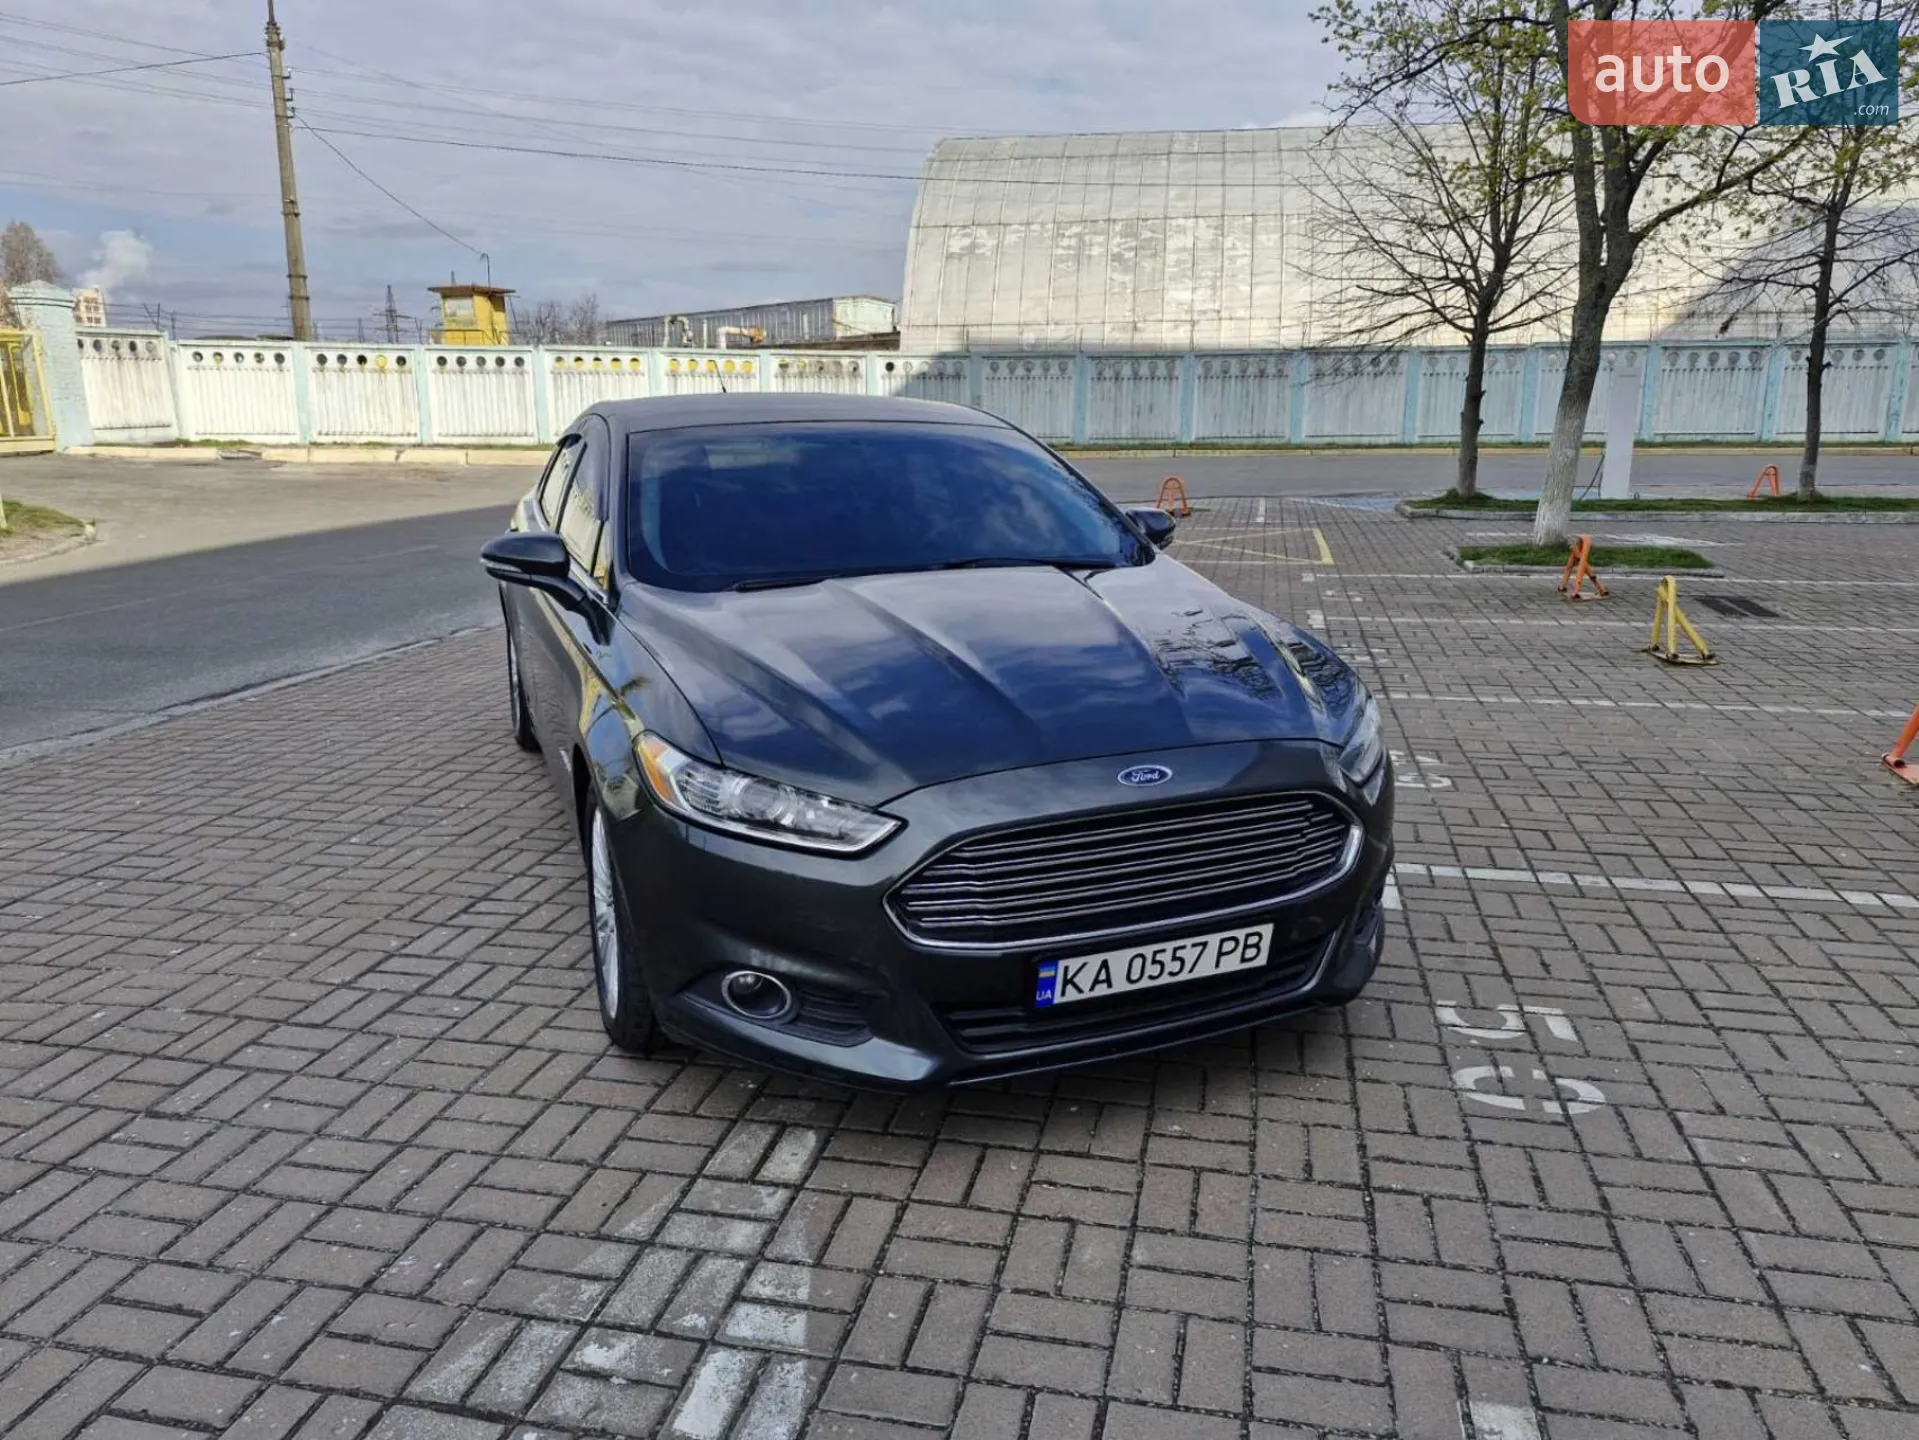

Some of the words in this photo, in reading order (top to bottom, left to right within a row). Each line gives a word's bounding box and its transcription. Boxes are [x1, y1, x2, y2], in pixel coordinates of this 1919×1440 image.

[1060, 959, 1113, 997] KA
[1125, 942, 1208, 985] 0557
[1214, 931, 1264, 968] PB
[1036, 989, 1053, 1001] UA
